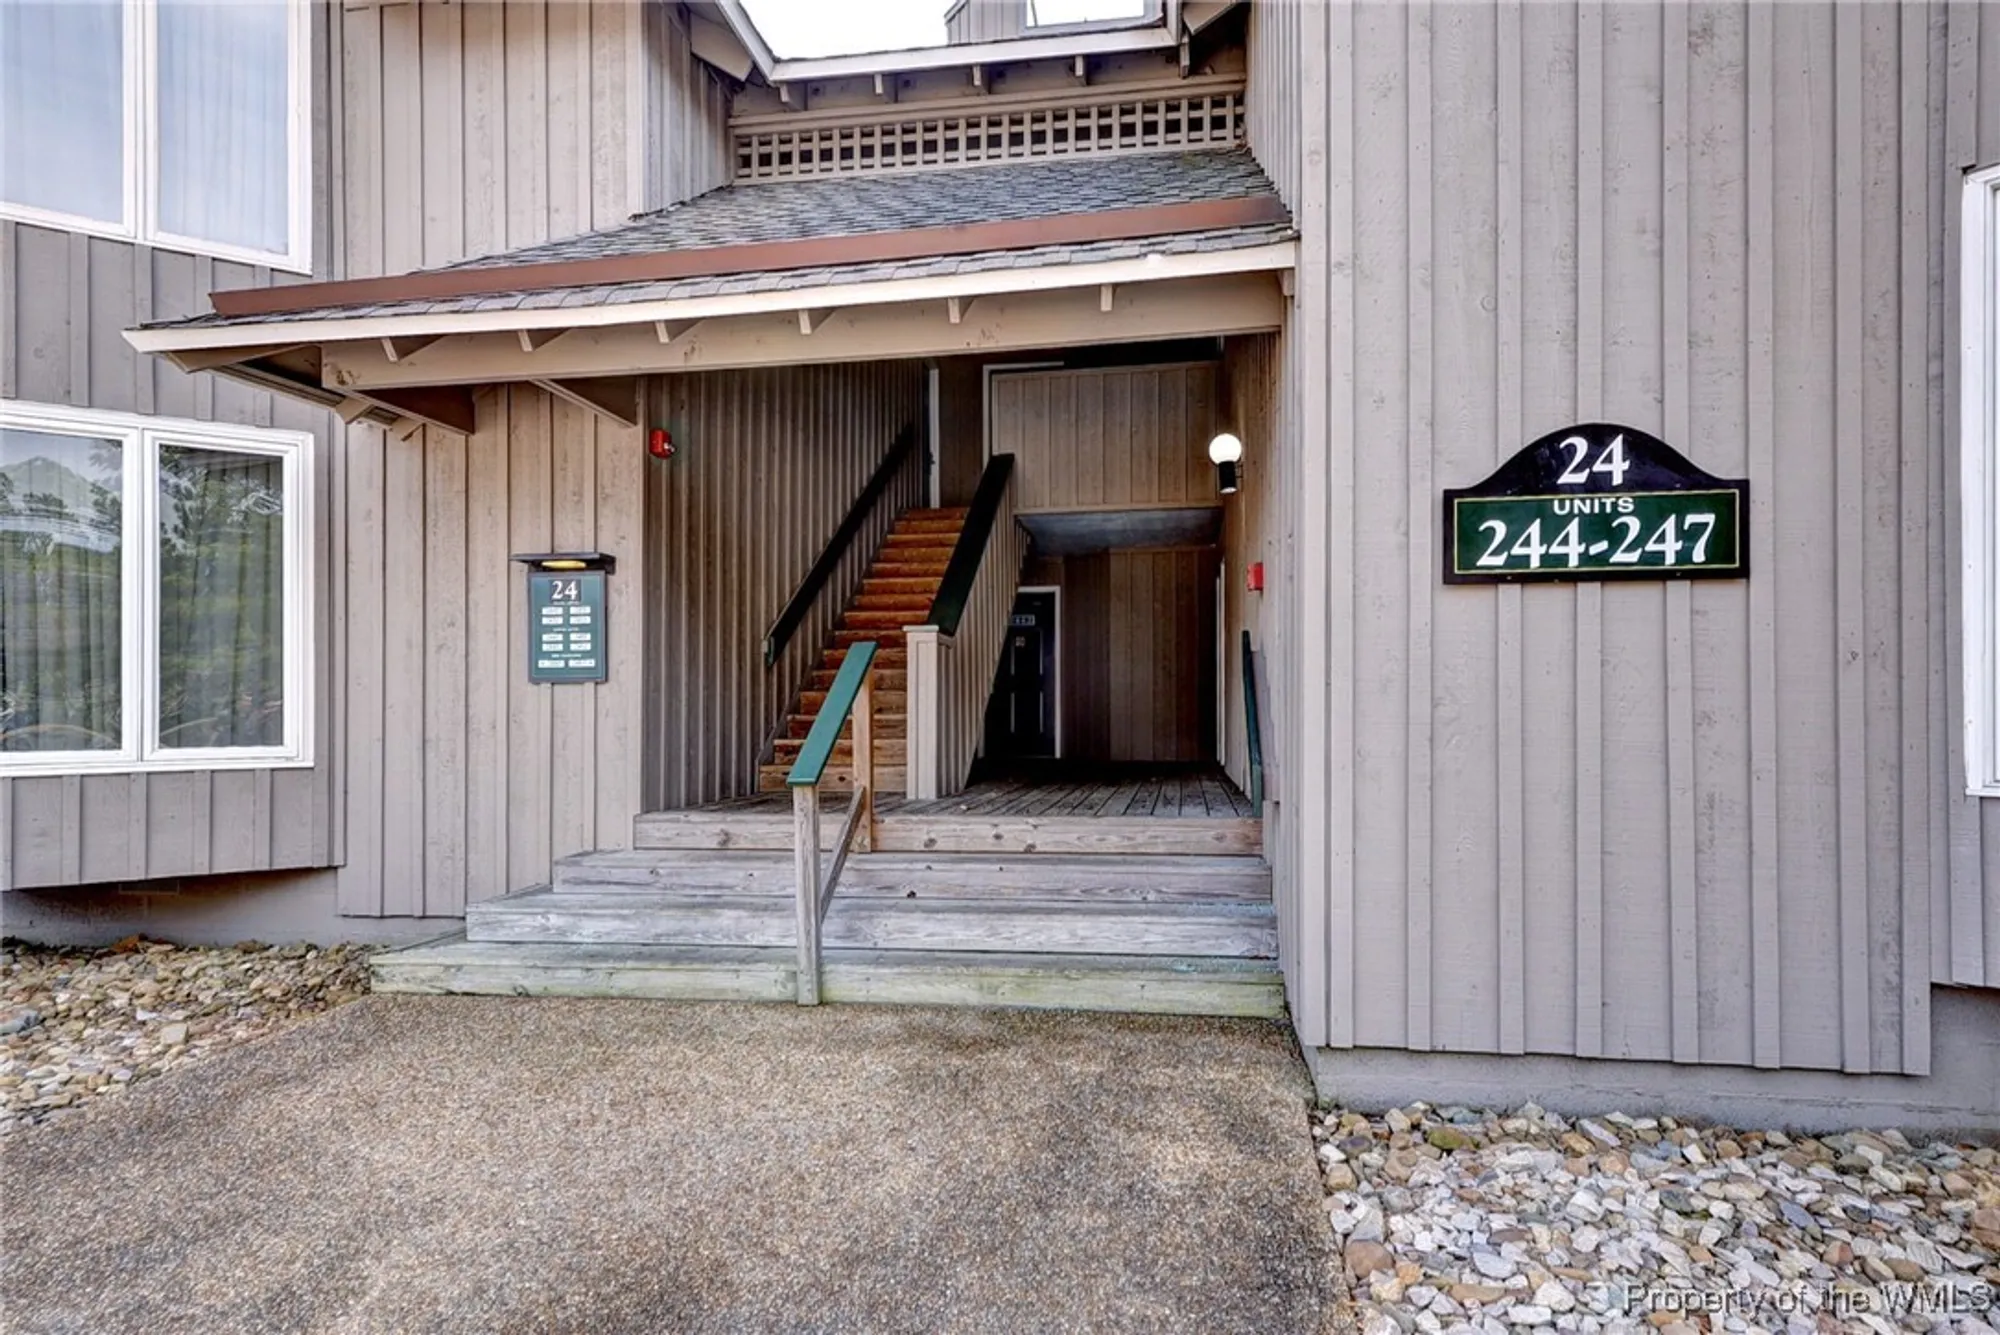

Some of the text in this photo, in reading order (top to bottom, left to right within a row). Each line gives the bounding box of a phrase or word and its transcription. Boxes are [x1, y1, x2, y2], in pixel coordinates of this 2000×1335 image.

[1556, 433, 1630, 486] 24
[1553, 496, 1635, 515] UNITS
[1476, 513, 1716, 569] 244-247
[551, 580, 578, 600] 24
